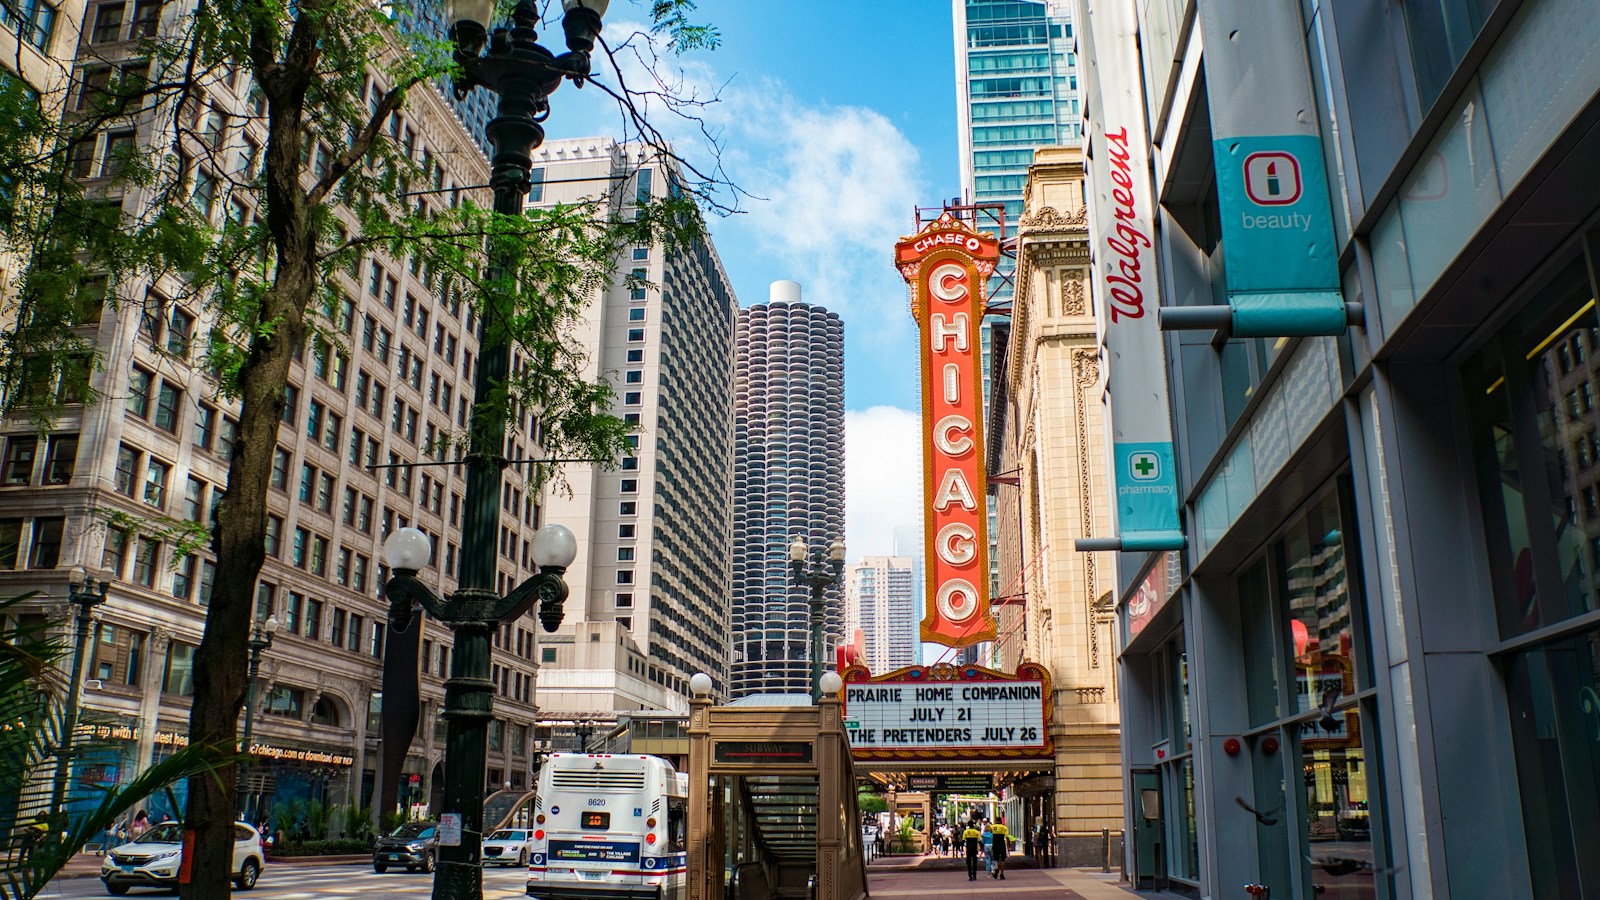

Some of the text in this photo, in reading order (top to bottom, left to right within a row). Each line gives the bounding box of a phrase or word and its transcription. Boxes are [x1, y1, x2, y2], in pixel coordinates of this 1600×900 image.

[1105, 126, 1151, 324] Walgreens
[1242, 211, 1312, 232] beauty
[914, 233, 965, 252] CHASE
[928, 263, 979, 624] CHICAGO
[1118, 485, 1174, 496] pharmacy
[847, 686, 1040, 702] PRAIRIE HOME COMPANION
[909, 707, 972, 721] JULY 21
[112, 725, 131, 739] with
[849, 727, 1037, 743] THE PRETENDERS JULY 26
[744, 743, 783, 753] SUBWAY
[298, 750, 306, 759] or
[305, 750, 333, 763] download
[333, 755, 343, 764] our
